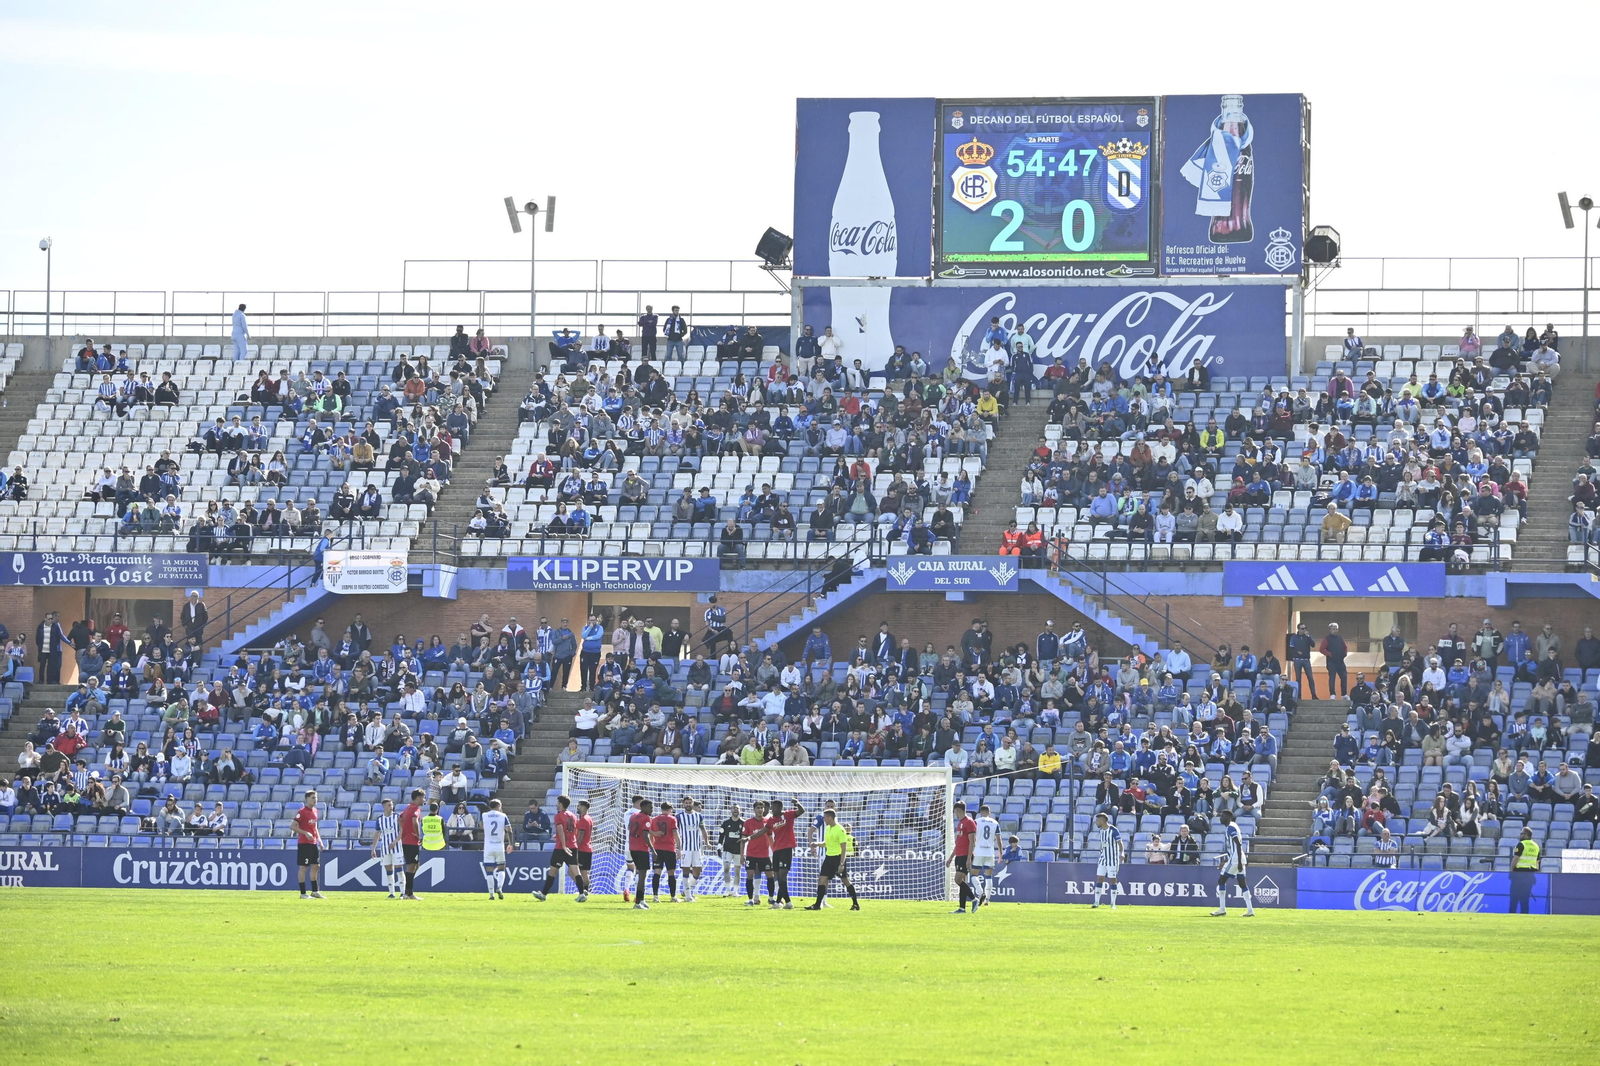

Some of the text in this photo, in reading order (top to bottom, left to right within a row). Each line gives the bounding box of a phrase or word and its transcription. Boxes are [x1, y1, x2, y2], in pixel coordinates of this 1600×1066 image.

[970, 112, 1124, 125] DECANO DEL FÚTBOL ESPAÑOL
[1006, 149, 1098, 178] 54:47
[989, 199, 1024, 252] 2
[1061, 199, 1095, 252] 0
[831, 220, 896, 256] Coca-Cola
[1166, 245, 1229, 254] Refresco Oficial del:
[1166, 256, 1246, 265] R.C. Recreativo de Huelva
[989, 266, 1105, 277] www.alosonido.net
[951, 292, 1234, 380] Coca-Cola
[42, 553, 152, 565] Bar Restaurante
[918, 561, 986, 572] CAJA RURAL
[41, 565, 152, 585] Juan José
[532, 559, 693, 581] KLIPERVIP
[581, 581, 600, 590] High
[603, 582, 652, 591] Technology
[490, 821, 498, 836] 2
[983, 825, 990, 840] 8
[0, 851, 59, 871] URAL
[113, 851, 288, 890] Cruzcampo
[1065, 880, 1207, 898] REPAHOSER
[1354, 870, 1492, 913] Coca-Cola
